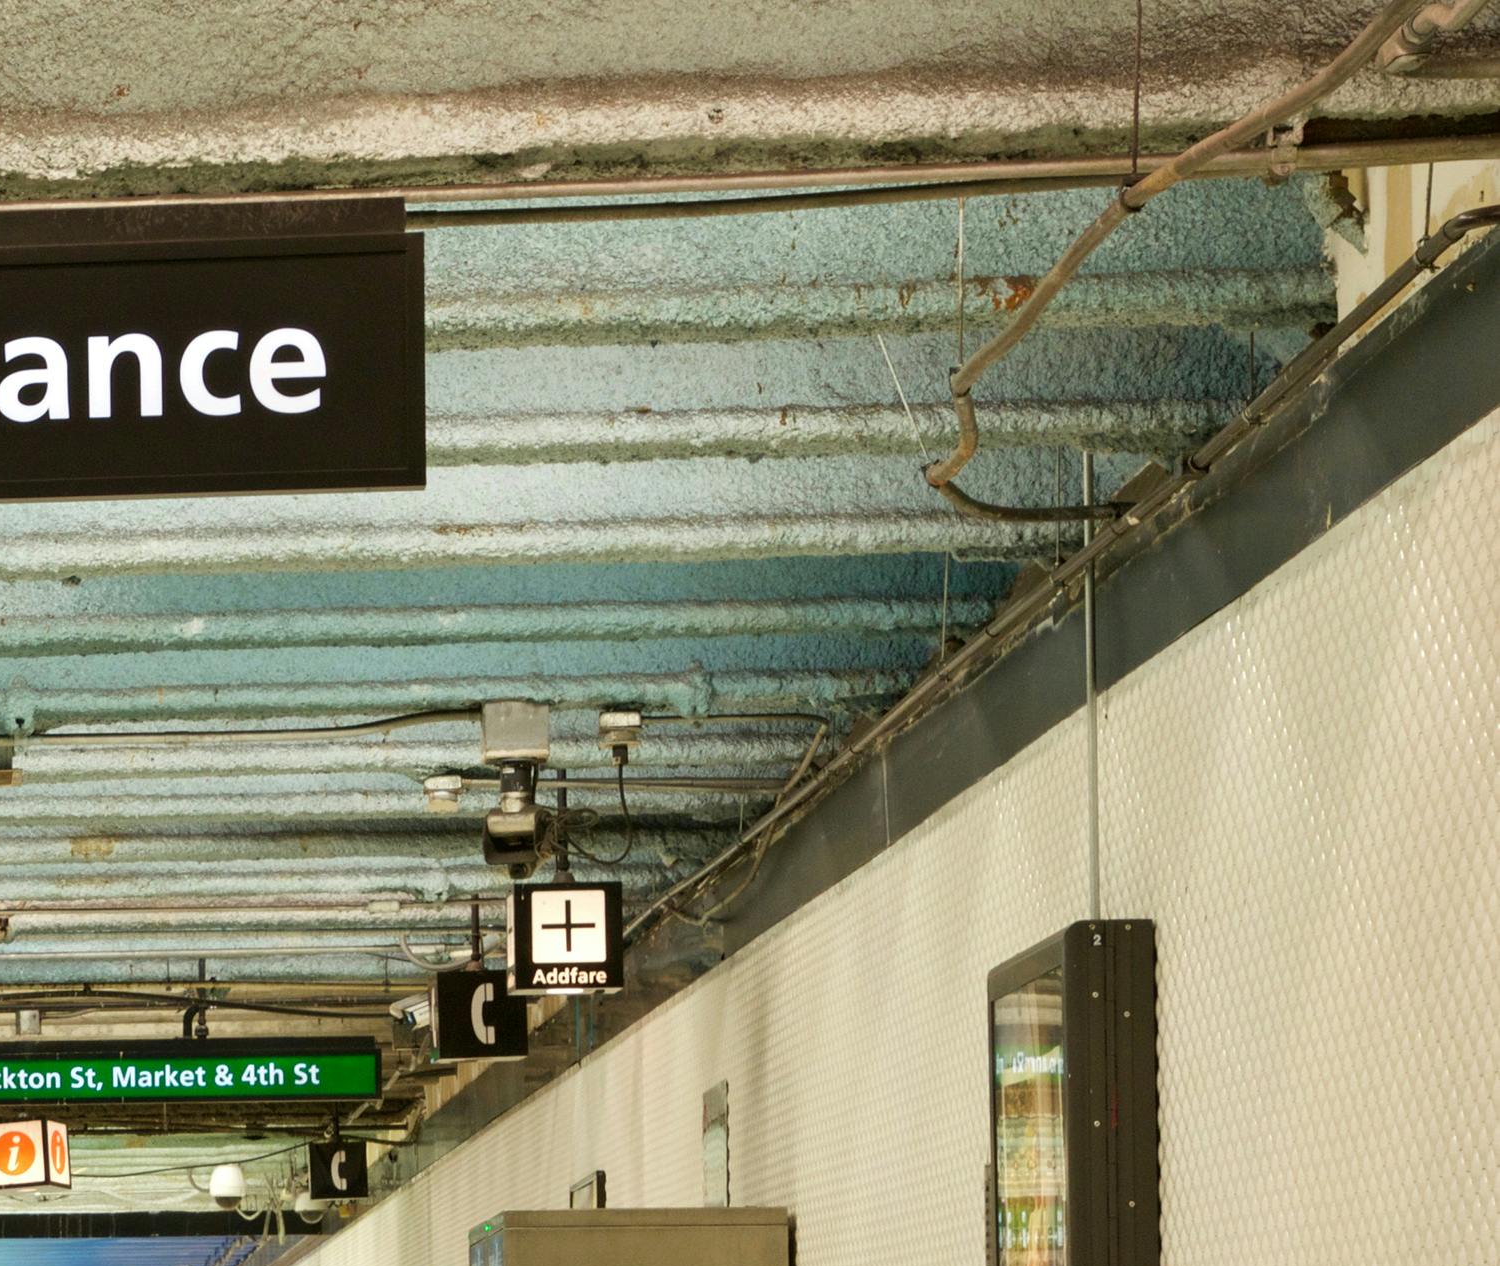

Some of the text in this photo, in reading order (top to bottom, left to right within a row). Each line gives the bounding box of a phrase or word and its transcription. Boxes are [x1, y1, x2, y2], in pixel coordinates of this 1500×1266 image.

[1092, 934, 1102, 946] 2
[532, 966, 607, 984] Addfare
[70, 1066, 104, 1091] St,
[112, 1064, 206, 1088] Market
[214, 1064, 234, 1086] &
[241, 1062, 285, 1086] 4th
[294, 1062, 321, 1085] St
